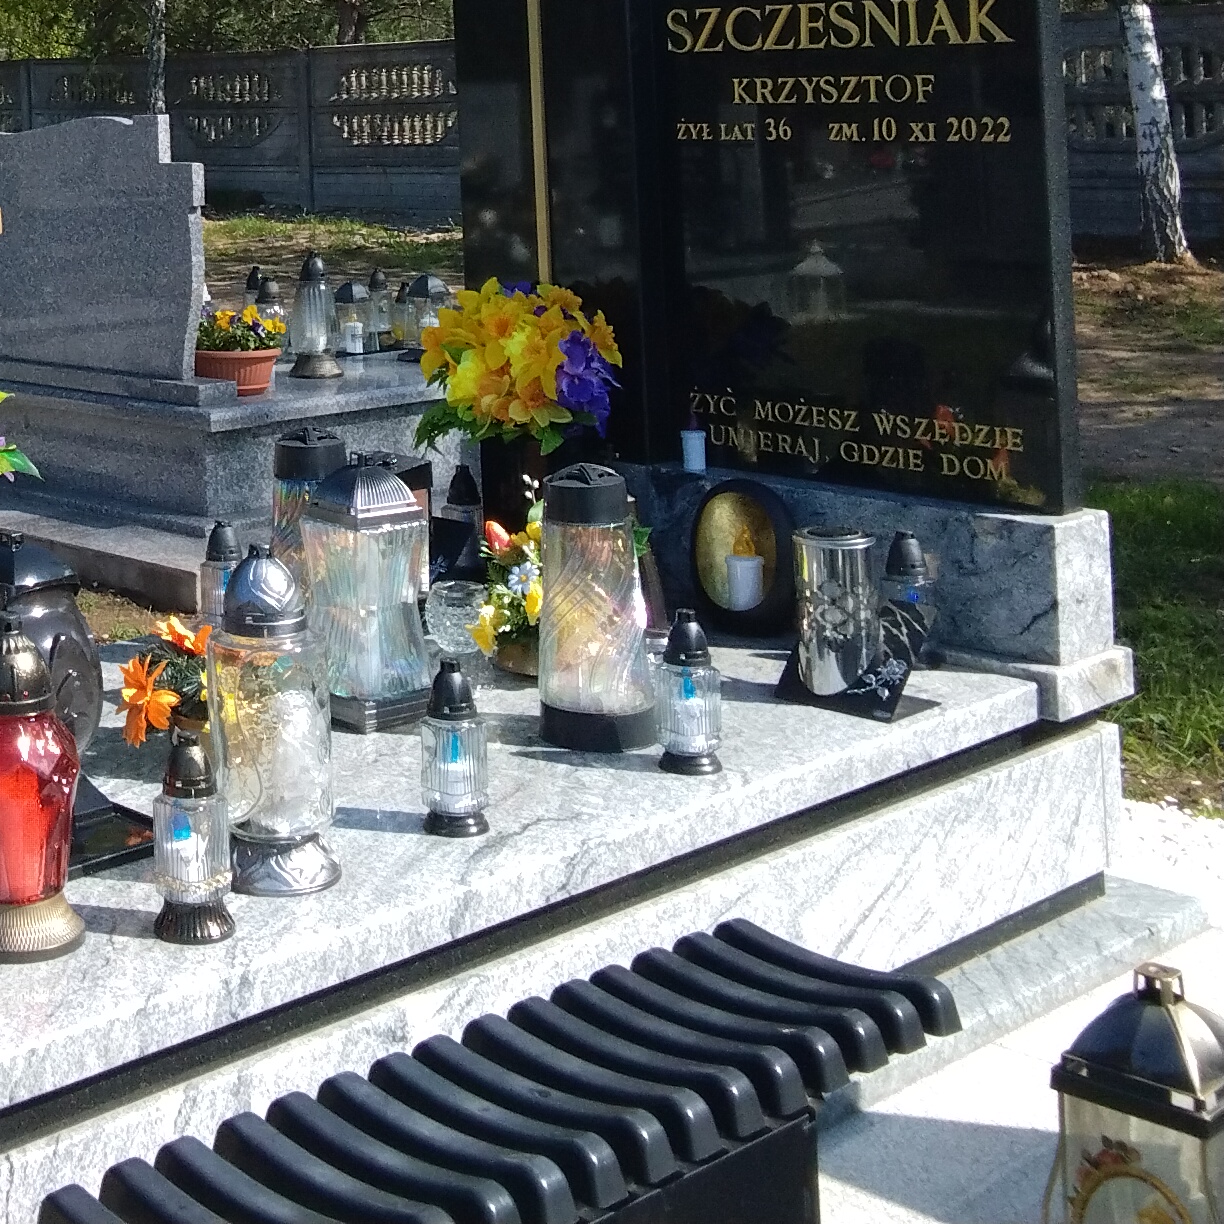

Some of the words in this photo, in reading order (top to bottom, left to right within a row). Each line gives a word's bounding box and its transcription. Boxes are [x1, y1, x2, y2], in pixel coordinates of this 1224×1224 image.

[731, 74, 935, 105] KRZYSZTOF
[677, 117, 714, 141] ŻYŁ
[719, 123, 756, 141] LAT
[764, 117, 792, 141] 36
[873, 116, 897, 142] 10
[908, 122, 937, 142] XI
[946, 116, 1012, 143] 2022
[689, 385, 737, 416] ŻYĆ
[754, 397, 860, 432] MOŻESZ
[871, 411, 1024, 452] WSZĘDZIE
[840, 441, 925, 472] GDZIE
[940, 453, 1007, 481] DOM
